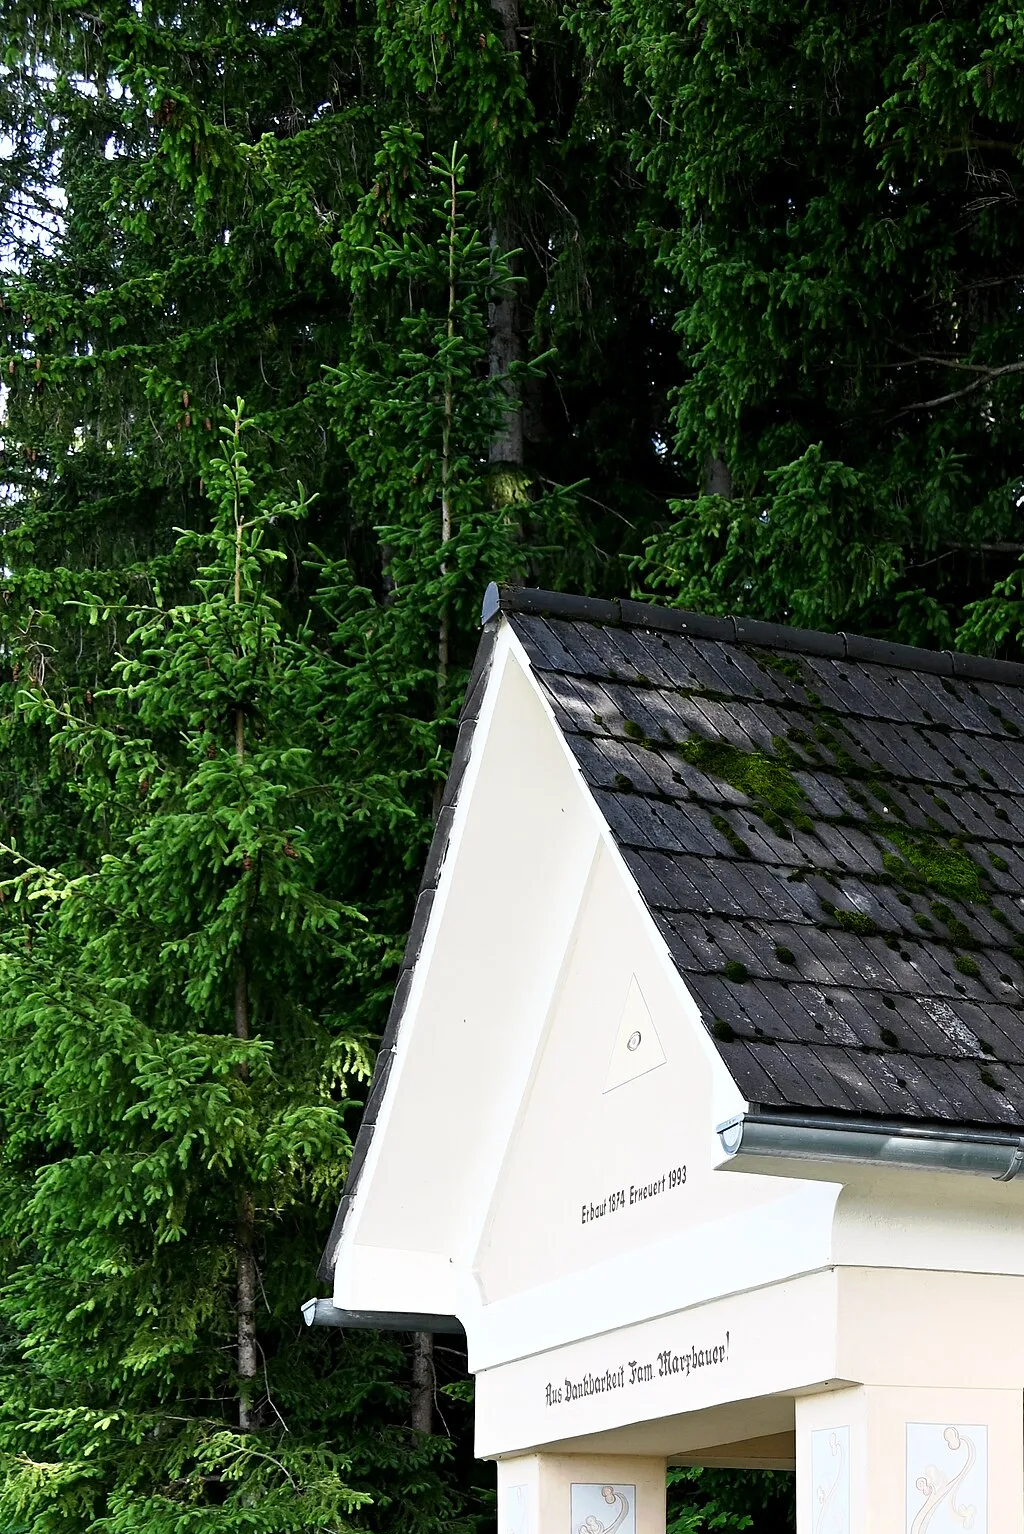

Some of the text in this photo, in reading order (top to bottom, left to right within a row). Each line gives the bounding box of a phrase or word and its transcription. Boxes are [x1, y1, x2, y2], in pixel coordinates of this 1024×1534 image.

[581, 1199, 607, 1224] Erbaut
[608, 1189, 625, 1213] 1874
[668, 1164, 687, 1190] 1993
[545, 1382, 562, 1407] Aus
[564, 1367, 624, 1402] Dankbarkeit
[628, 1360, 656, 1384] Fam.
